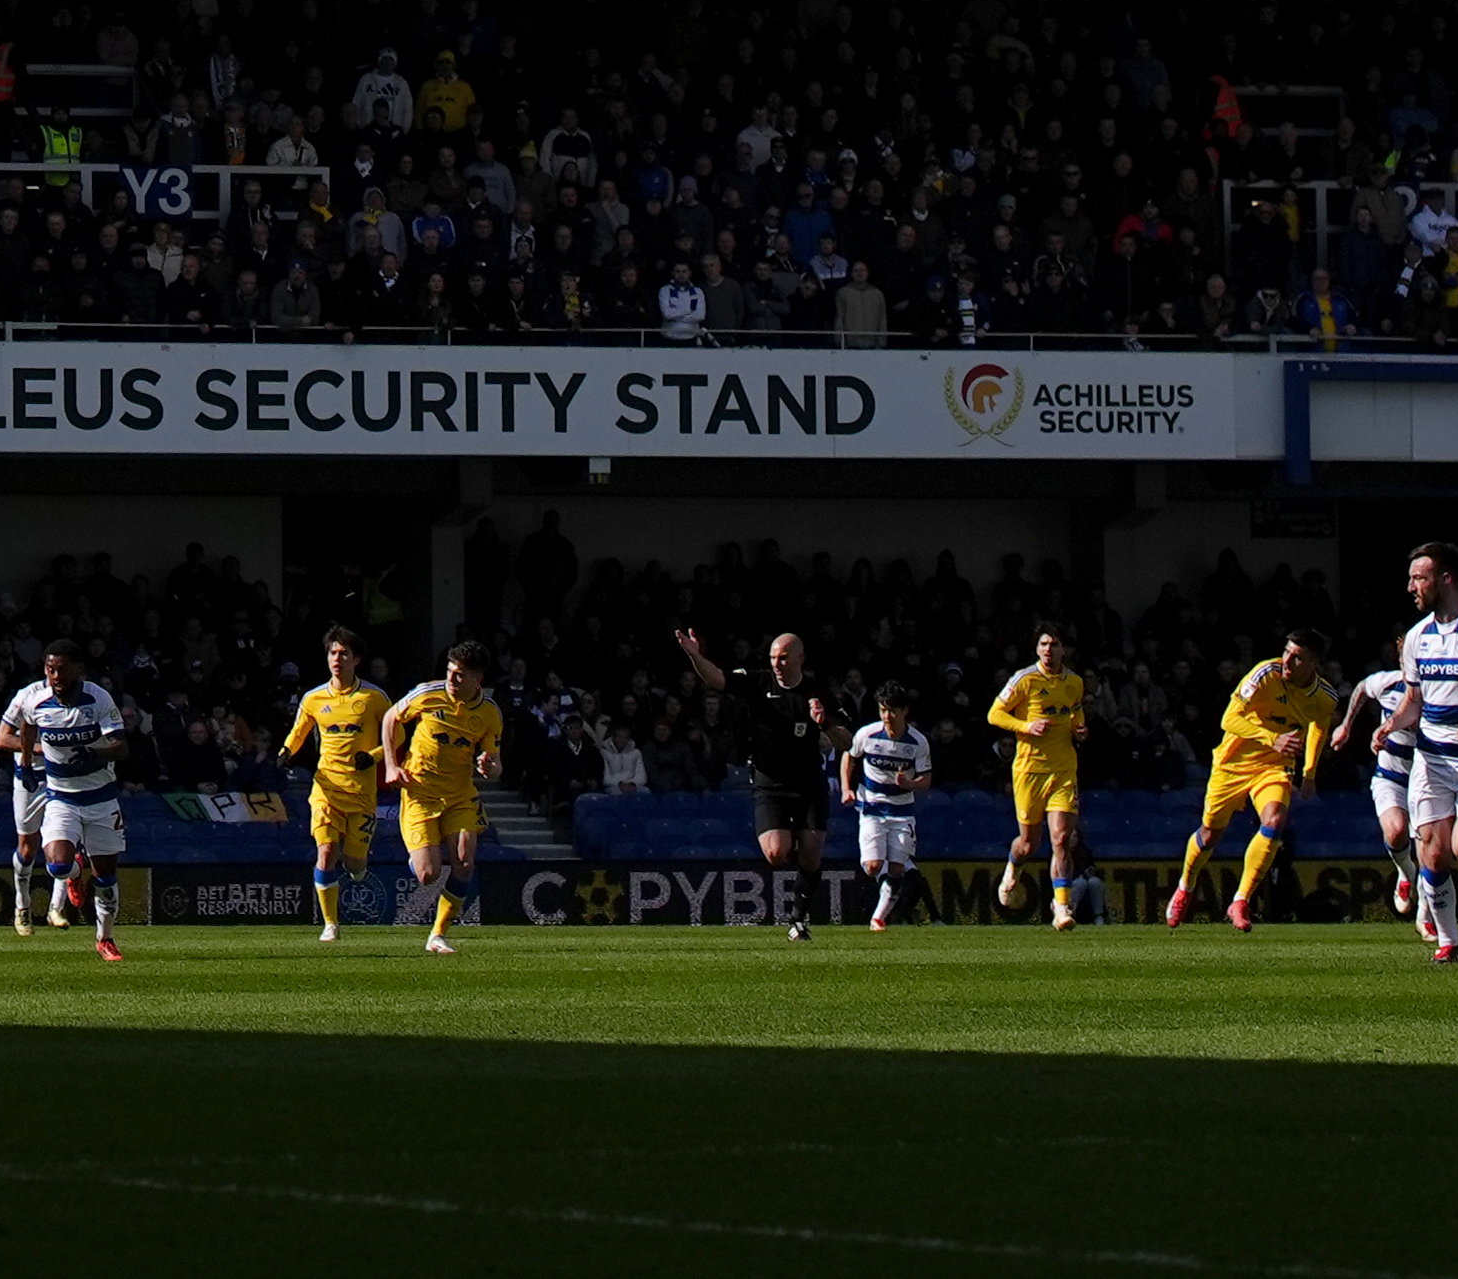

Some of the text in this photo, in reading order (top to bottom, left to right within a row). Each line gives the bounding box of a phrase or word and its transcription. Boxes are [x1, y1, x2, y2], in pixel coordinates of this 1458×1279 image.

[122, 167, 193, 216] Y3
[194, 368, 588, 434] SECURITY
[615, 372, 877, 437] STAND
[1032, 383, 1195, 408] ACHILLEUS
[1039, 410, 1181, 435] SECURITY
[196, 883, 302, 902] BET BET BET
[196, 900, 302, 916] RESPONSIBLY
